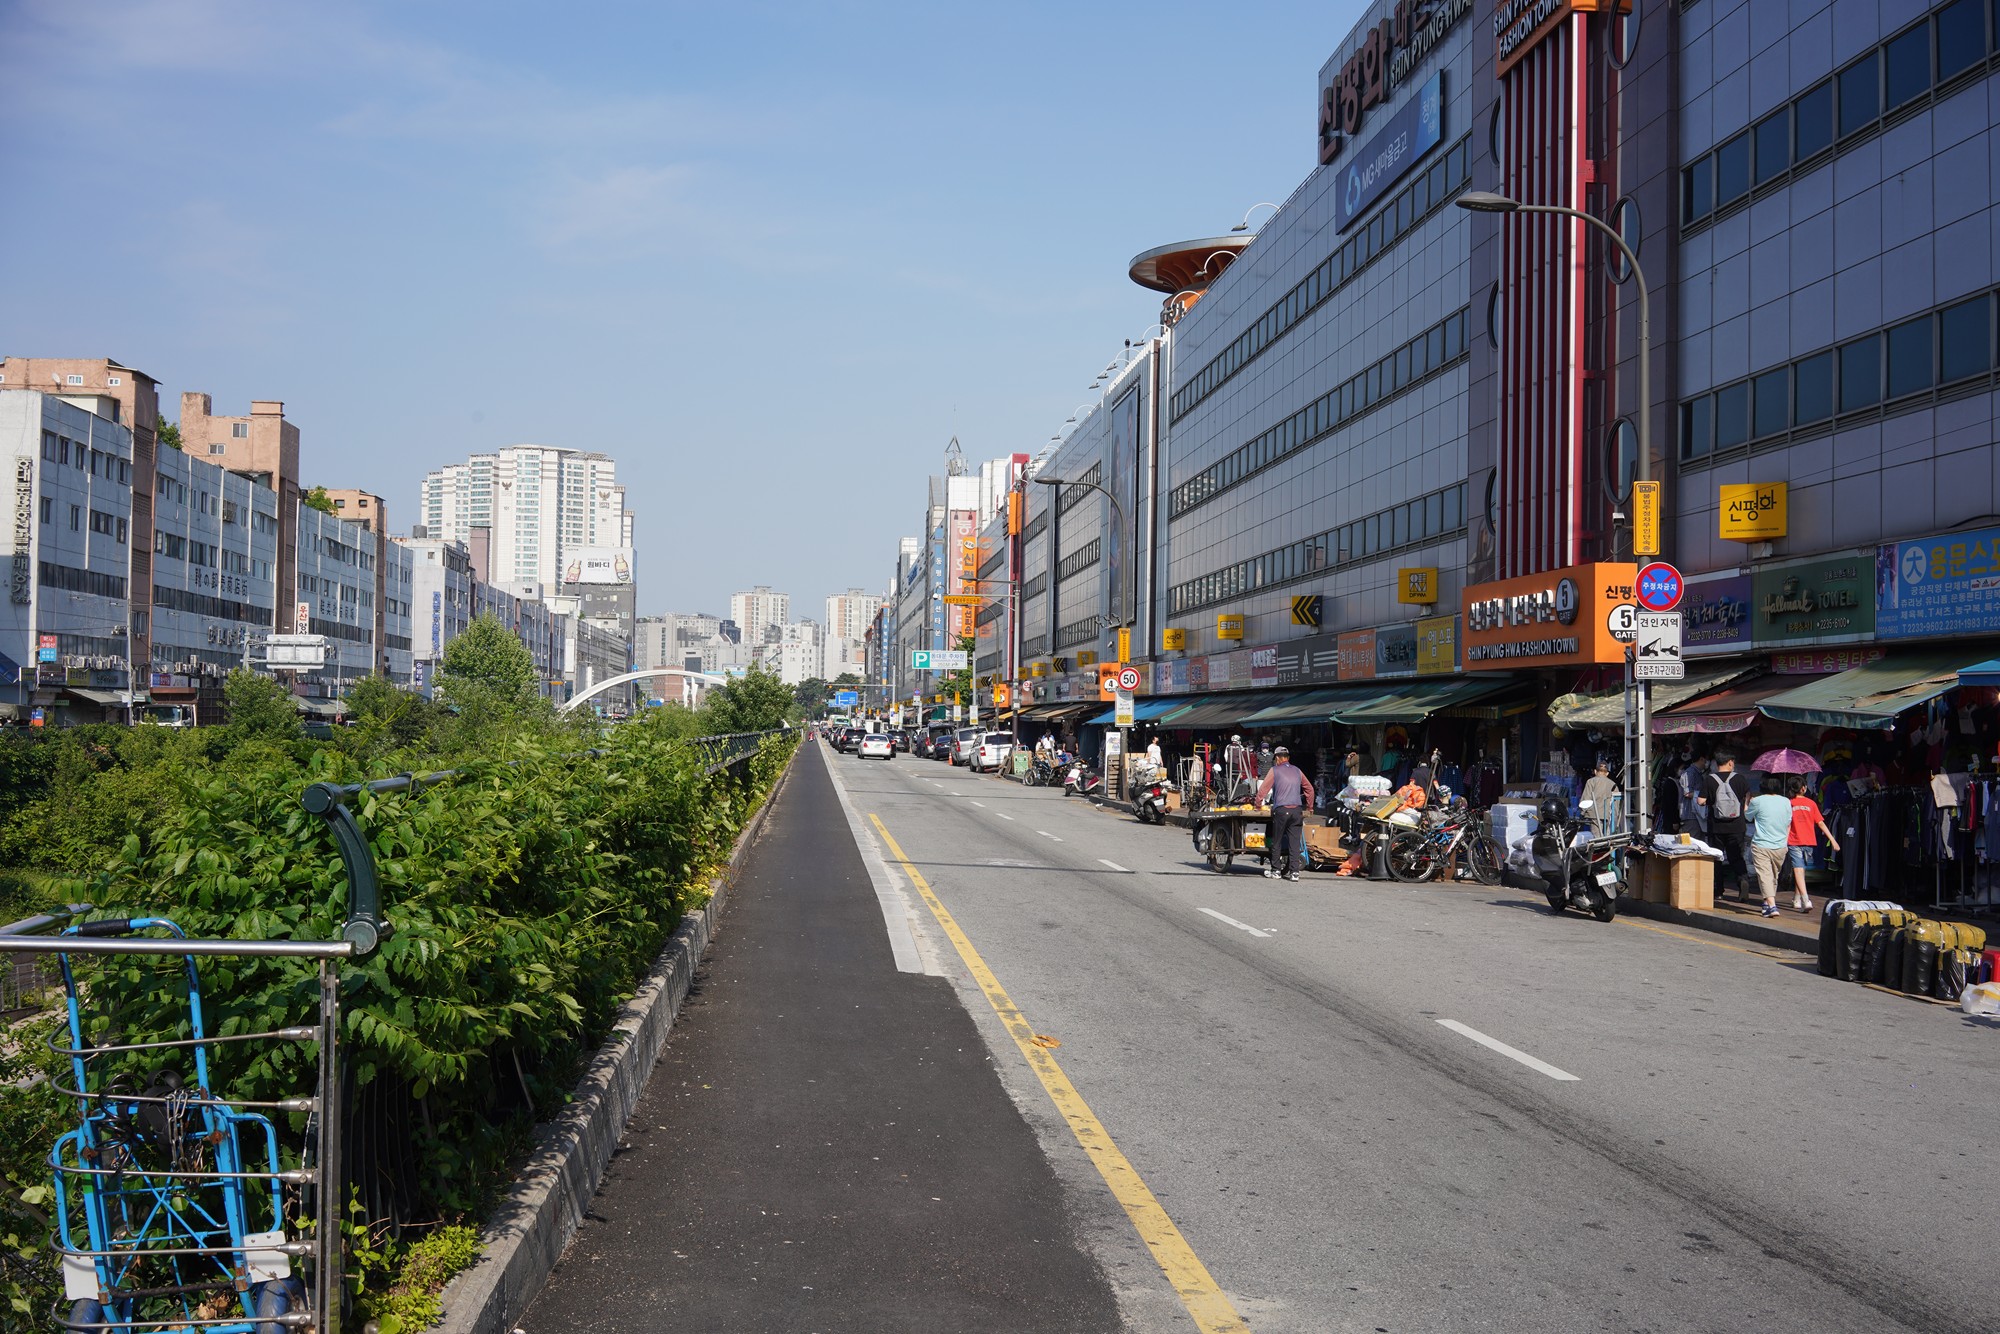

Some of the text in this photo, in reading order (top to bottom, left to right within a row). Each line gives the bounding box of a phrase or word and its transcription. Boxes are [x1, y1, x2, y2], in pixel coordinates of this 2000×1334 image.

[1499, 10, 1532, 61] FASHION
[1391, 48, 1410, 89] SHIN
[1412, 14, 1445, 66] PYUNG
[1362, 131, 1407, 192] MG새마을금고
[1729, 489, 1777, 522] 신평화
[1606, 585, 1637, 600] 신평
[1643, 582, 1677, 591] 주정차금지
[1562, 585, 1568, 608] 5
[1314, 608, 1320, 616] 4
[1761, 589, 1813, 625] Hallmark
[1560, 611, 1571, 620] GATE
[1621, 609, 1632, 628] 5
[1640, 618, 1679, 628] 견인지역
[1615, 631, 1637, 639] GATE
[1468, 637, 1575, 660] SHIN PYUNG HWA FASHION TOWN
[915, 653, 928, 667] P
[1638, 665, 1682, 676] 조합주차구간제외
[1123, 674, 1136, 685] 50
